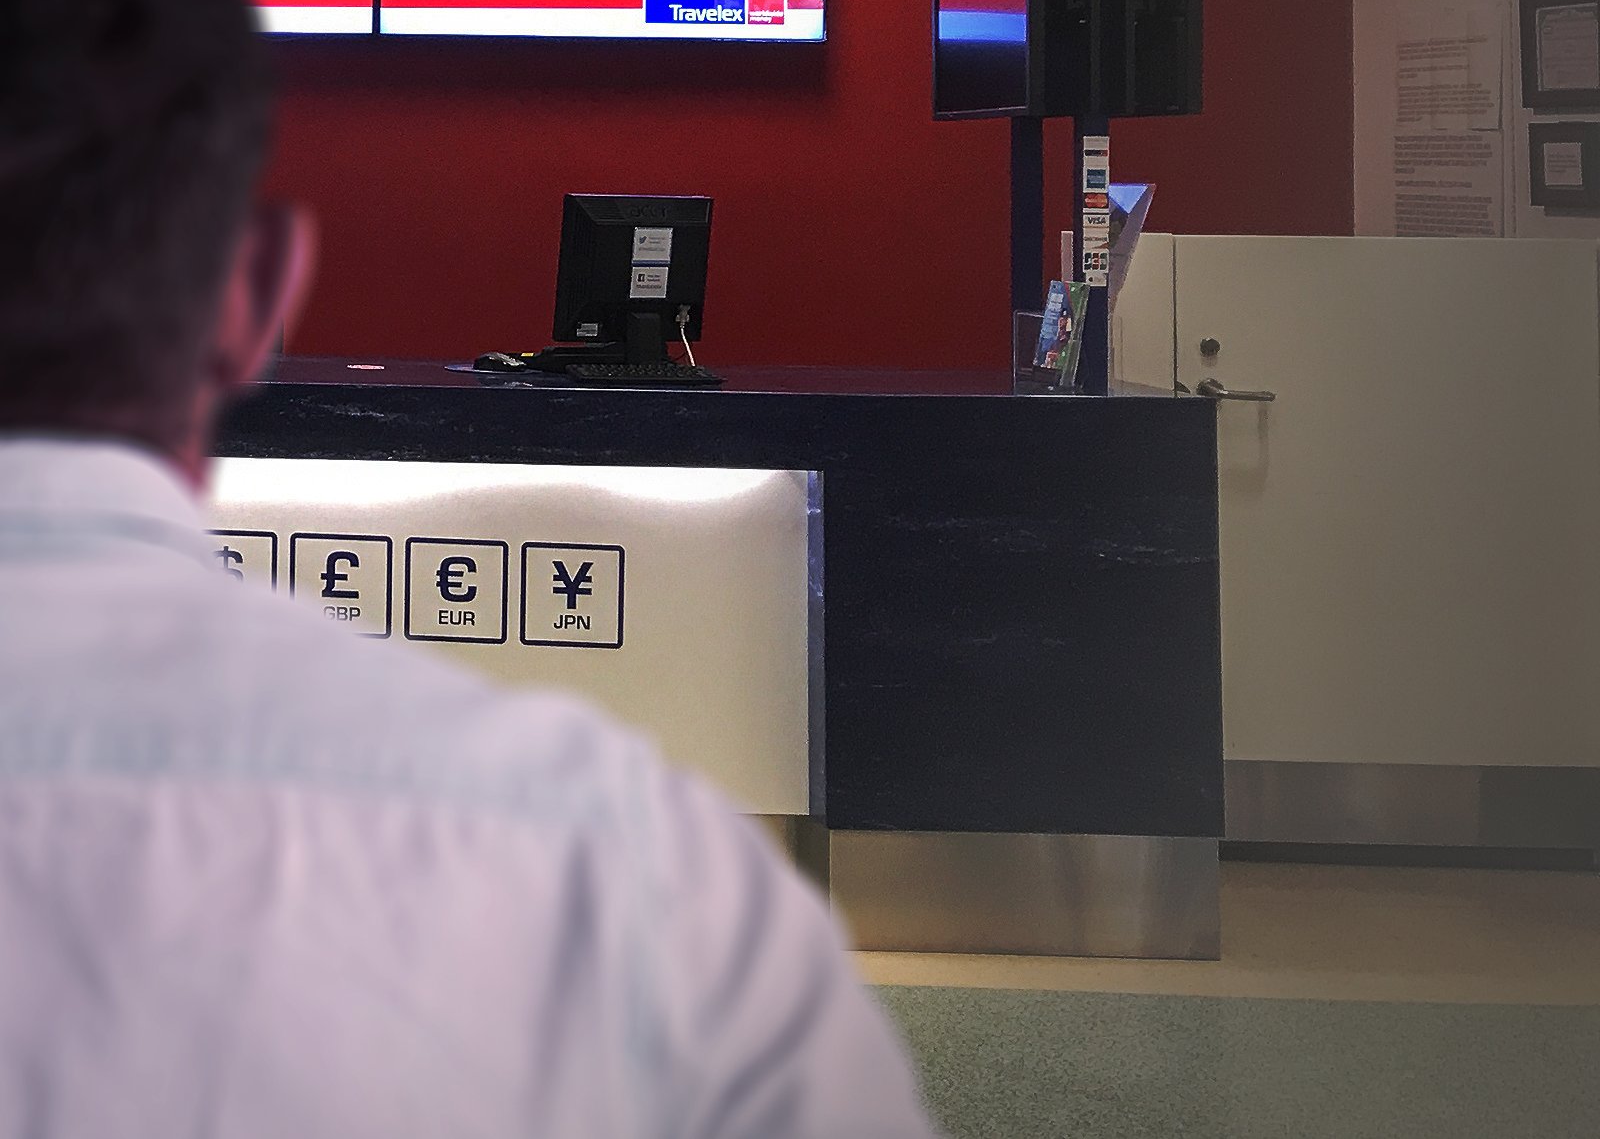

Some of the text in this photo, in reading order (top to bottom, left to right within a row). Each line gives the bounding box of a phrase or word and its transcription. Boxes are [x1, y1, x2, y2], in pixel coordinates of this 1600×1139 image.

[668, 3, 744, 22] Travelex
[1087, 216, 1107, 225] VISA
[320, 550, 360, 600] £
[435, 555, 478, 603] €
[551, 560, 595, 610] ¥
[437, 609, 476, 627] EUR
[553, 614, 592, 631] JPN
